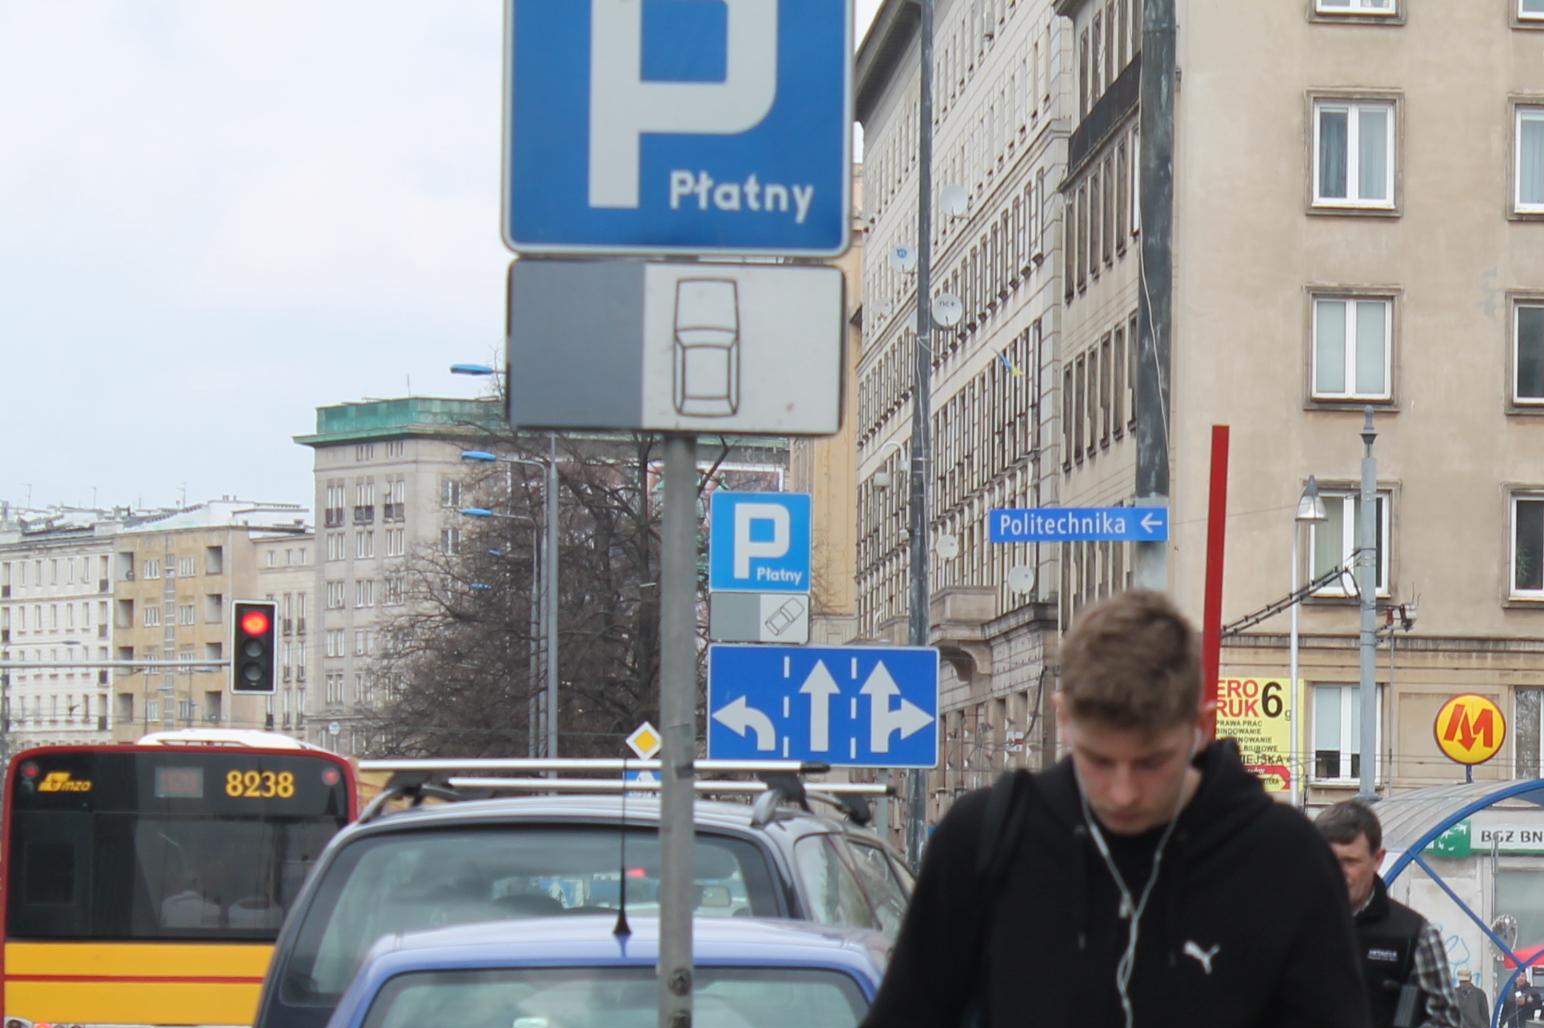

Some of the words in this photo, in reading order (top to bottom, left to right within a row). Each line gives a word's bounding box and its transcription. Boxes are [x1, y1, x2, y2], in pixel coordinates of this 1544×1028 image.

[588, 0, 778, 208] P
[670, 170, 814, 224] Płatny
[734, 503, 790, 579] P
[1000, 512, 1126, 536] Politechnika
[757, 566, 802, 586] Płatny
[1262, 681, 1283, 718] 6
[225, 769, 295, 798] 8238
